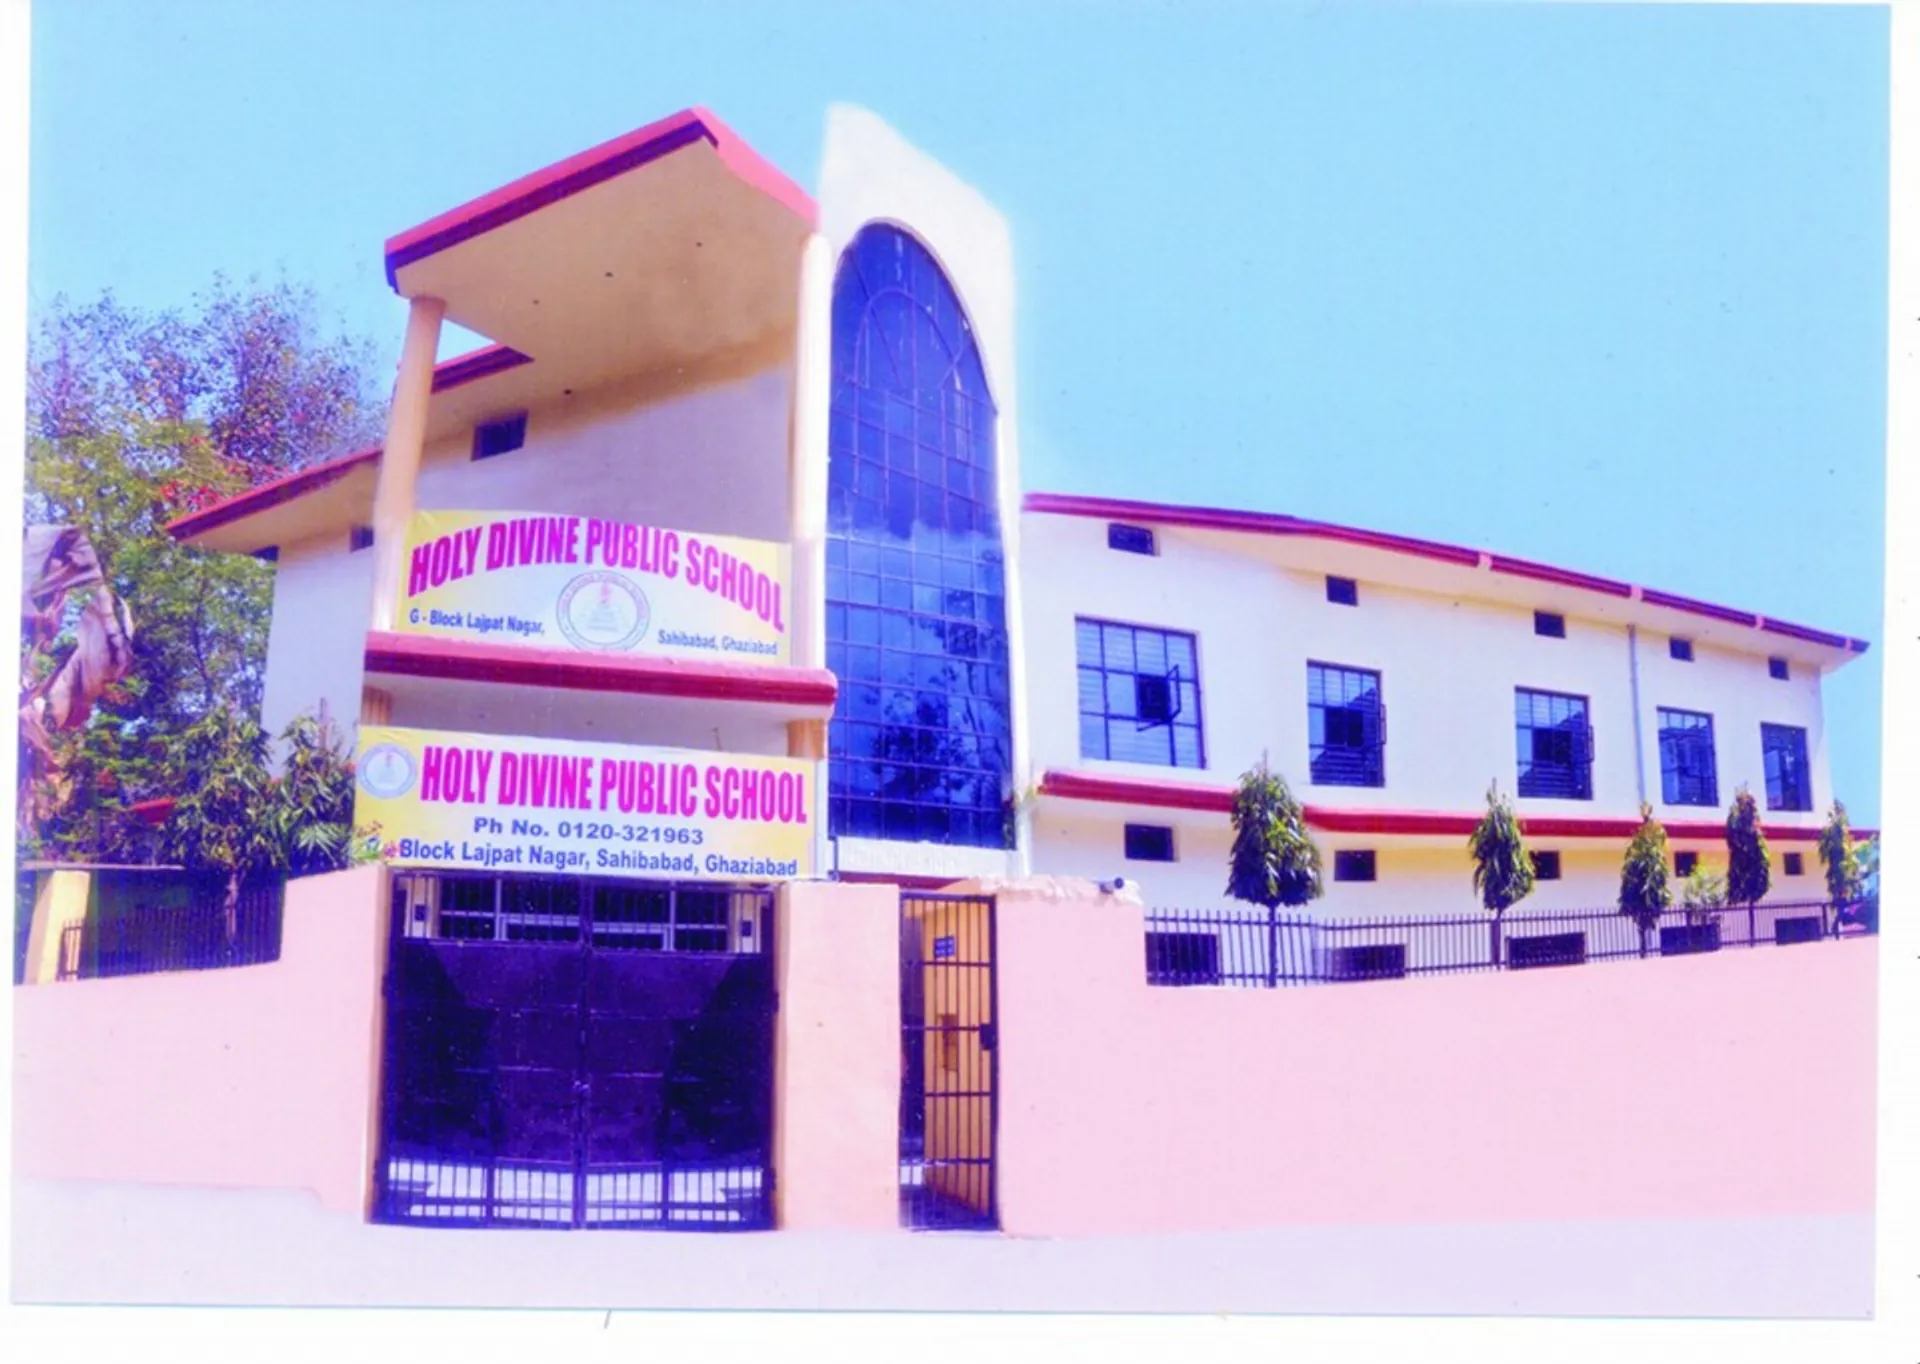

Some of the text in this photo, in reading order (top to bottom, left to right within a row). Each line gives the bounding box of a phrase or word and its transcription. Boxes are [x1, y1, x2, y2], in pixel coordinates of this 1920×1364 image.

[408, 526, 482, 597] HOLY
[486, 517, 580, 571] DIVINE
[585, 518, 679, 579] PUBLIC
[686, 538, 784, 633] SCHOOL
[410, 608, 420, 624] G
[430, 610, 463, 626] Block
[467, 612, 504, 633] Lajpat
[507, 616, 545, 636] Nagar,
[658, 629, 777, 655] Sahibabad, Ghaziabad
[420, 746, 494, 804] HOLY
[498, 752, 594, 810] DIVINE
[600, 759, 697, 817] PUBLIC
[705, 766, 807, 824] SCHOOL
[474, 817, 704, 845] Ph No. 0120-321963
[400, 838, 455, 860] Block
[462, 842, 523, 866] Lajpat
[529, 846, 590, 871] Nagar,
[597, 848, 699, 875] Sahibabad,
[705, 854, 798, 875] Ghaziabad
